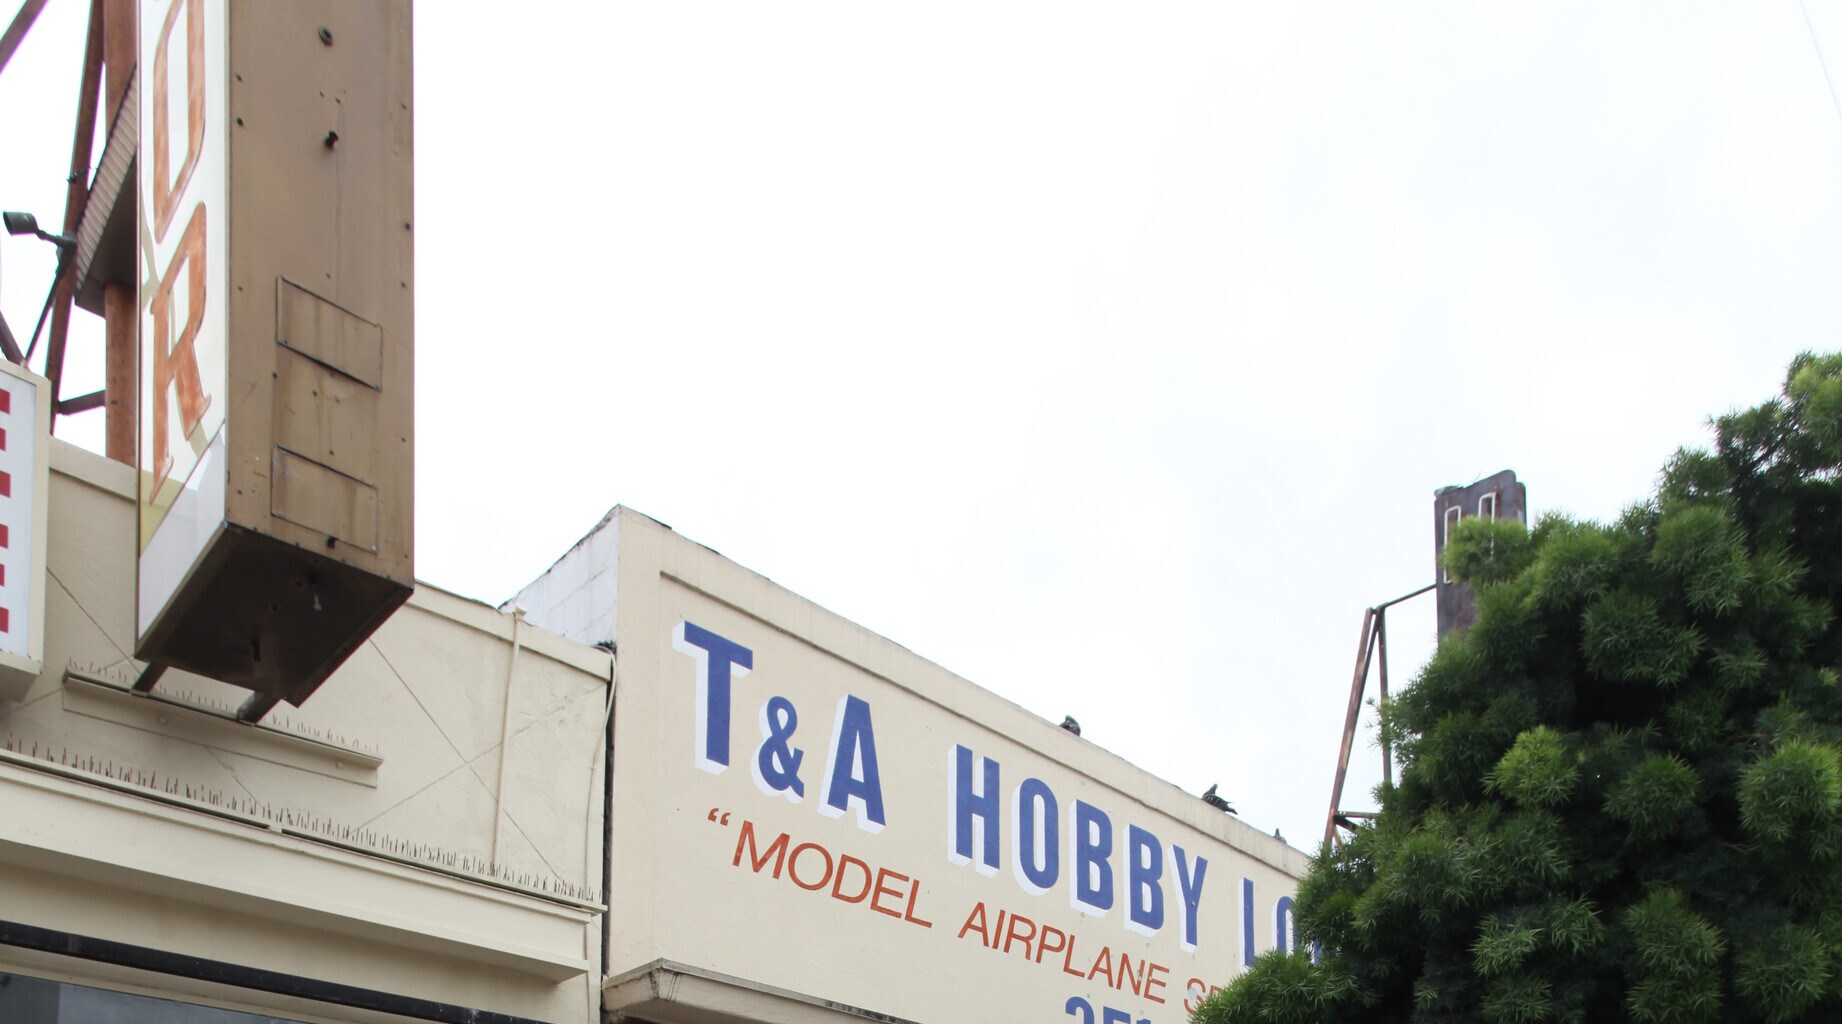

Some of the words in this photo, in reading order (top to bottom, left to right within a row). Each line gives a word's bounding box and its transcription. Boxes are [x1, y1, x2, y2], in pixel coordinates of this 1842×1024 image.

[672, 620, 886, 834] T&A
[947, 744, 1208, 953] HOBBY
[958, 901, 1170, 1005] AIRPLANE
